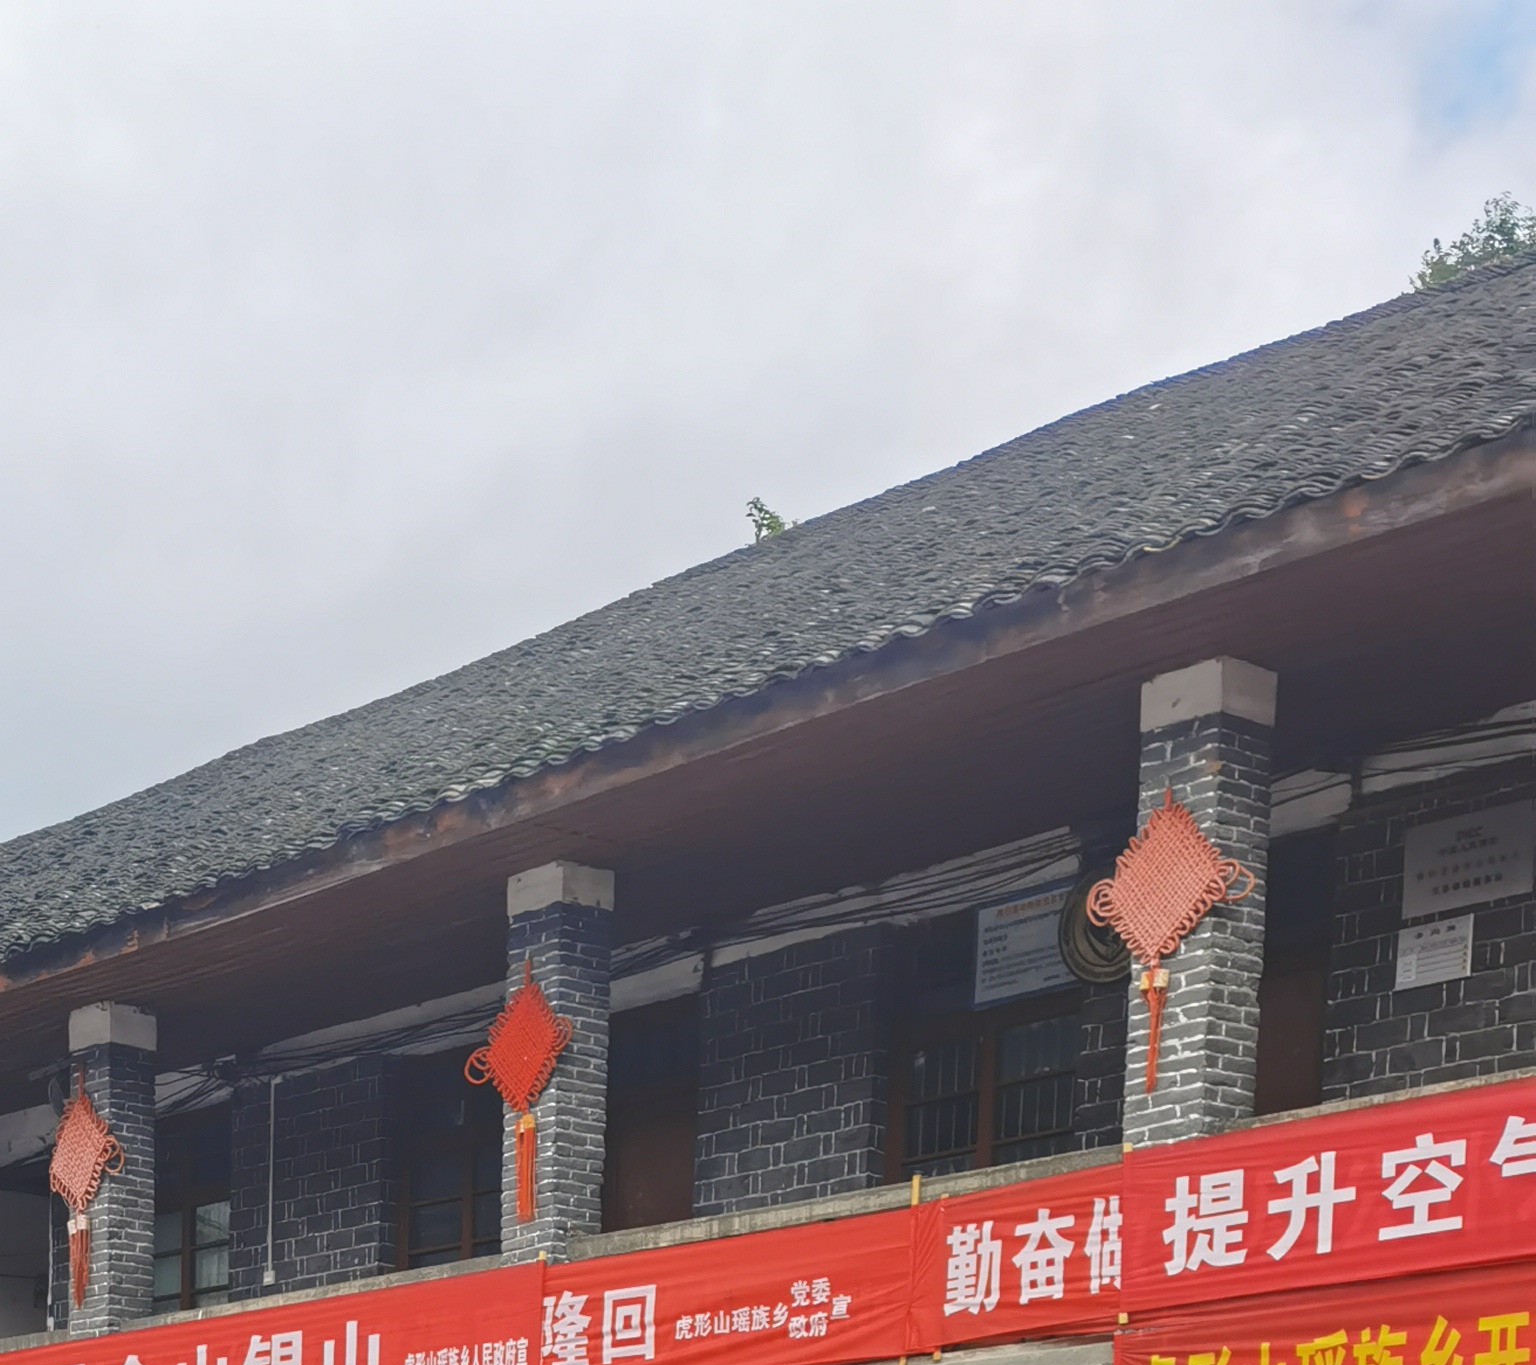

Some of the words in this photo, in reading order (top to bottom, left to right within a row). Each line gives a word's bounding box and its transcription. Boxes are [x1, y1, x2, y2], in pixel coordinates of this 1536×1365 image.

[674, 1304, 788, 1341] 虎形山瑶族乡
[790, 1277, 831, 1308] 党委
[831, 1294, 851, 1320] 宣
[788, 1311, 829, 1340] 政府
